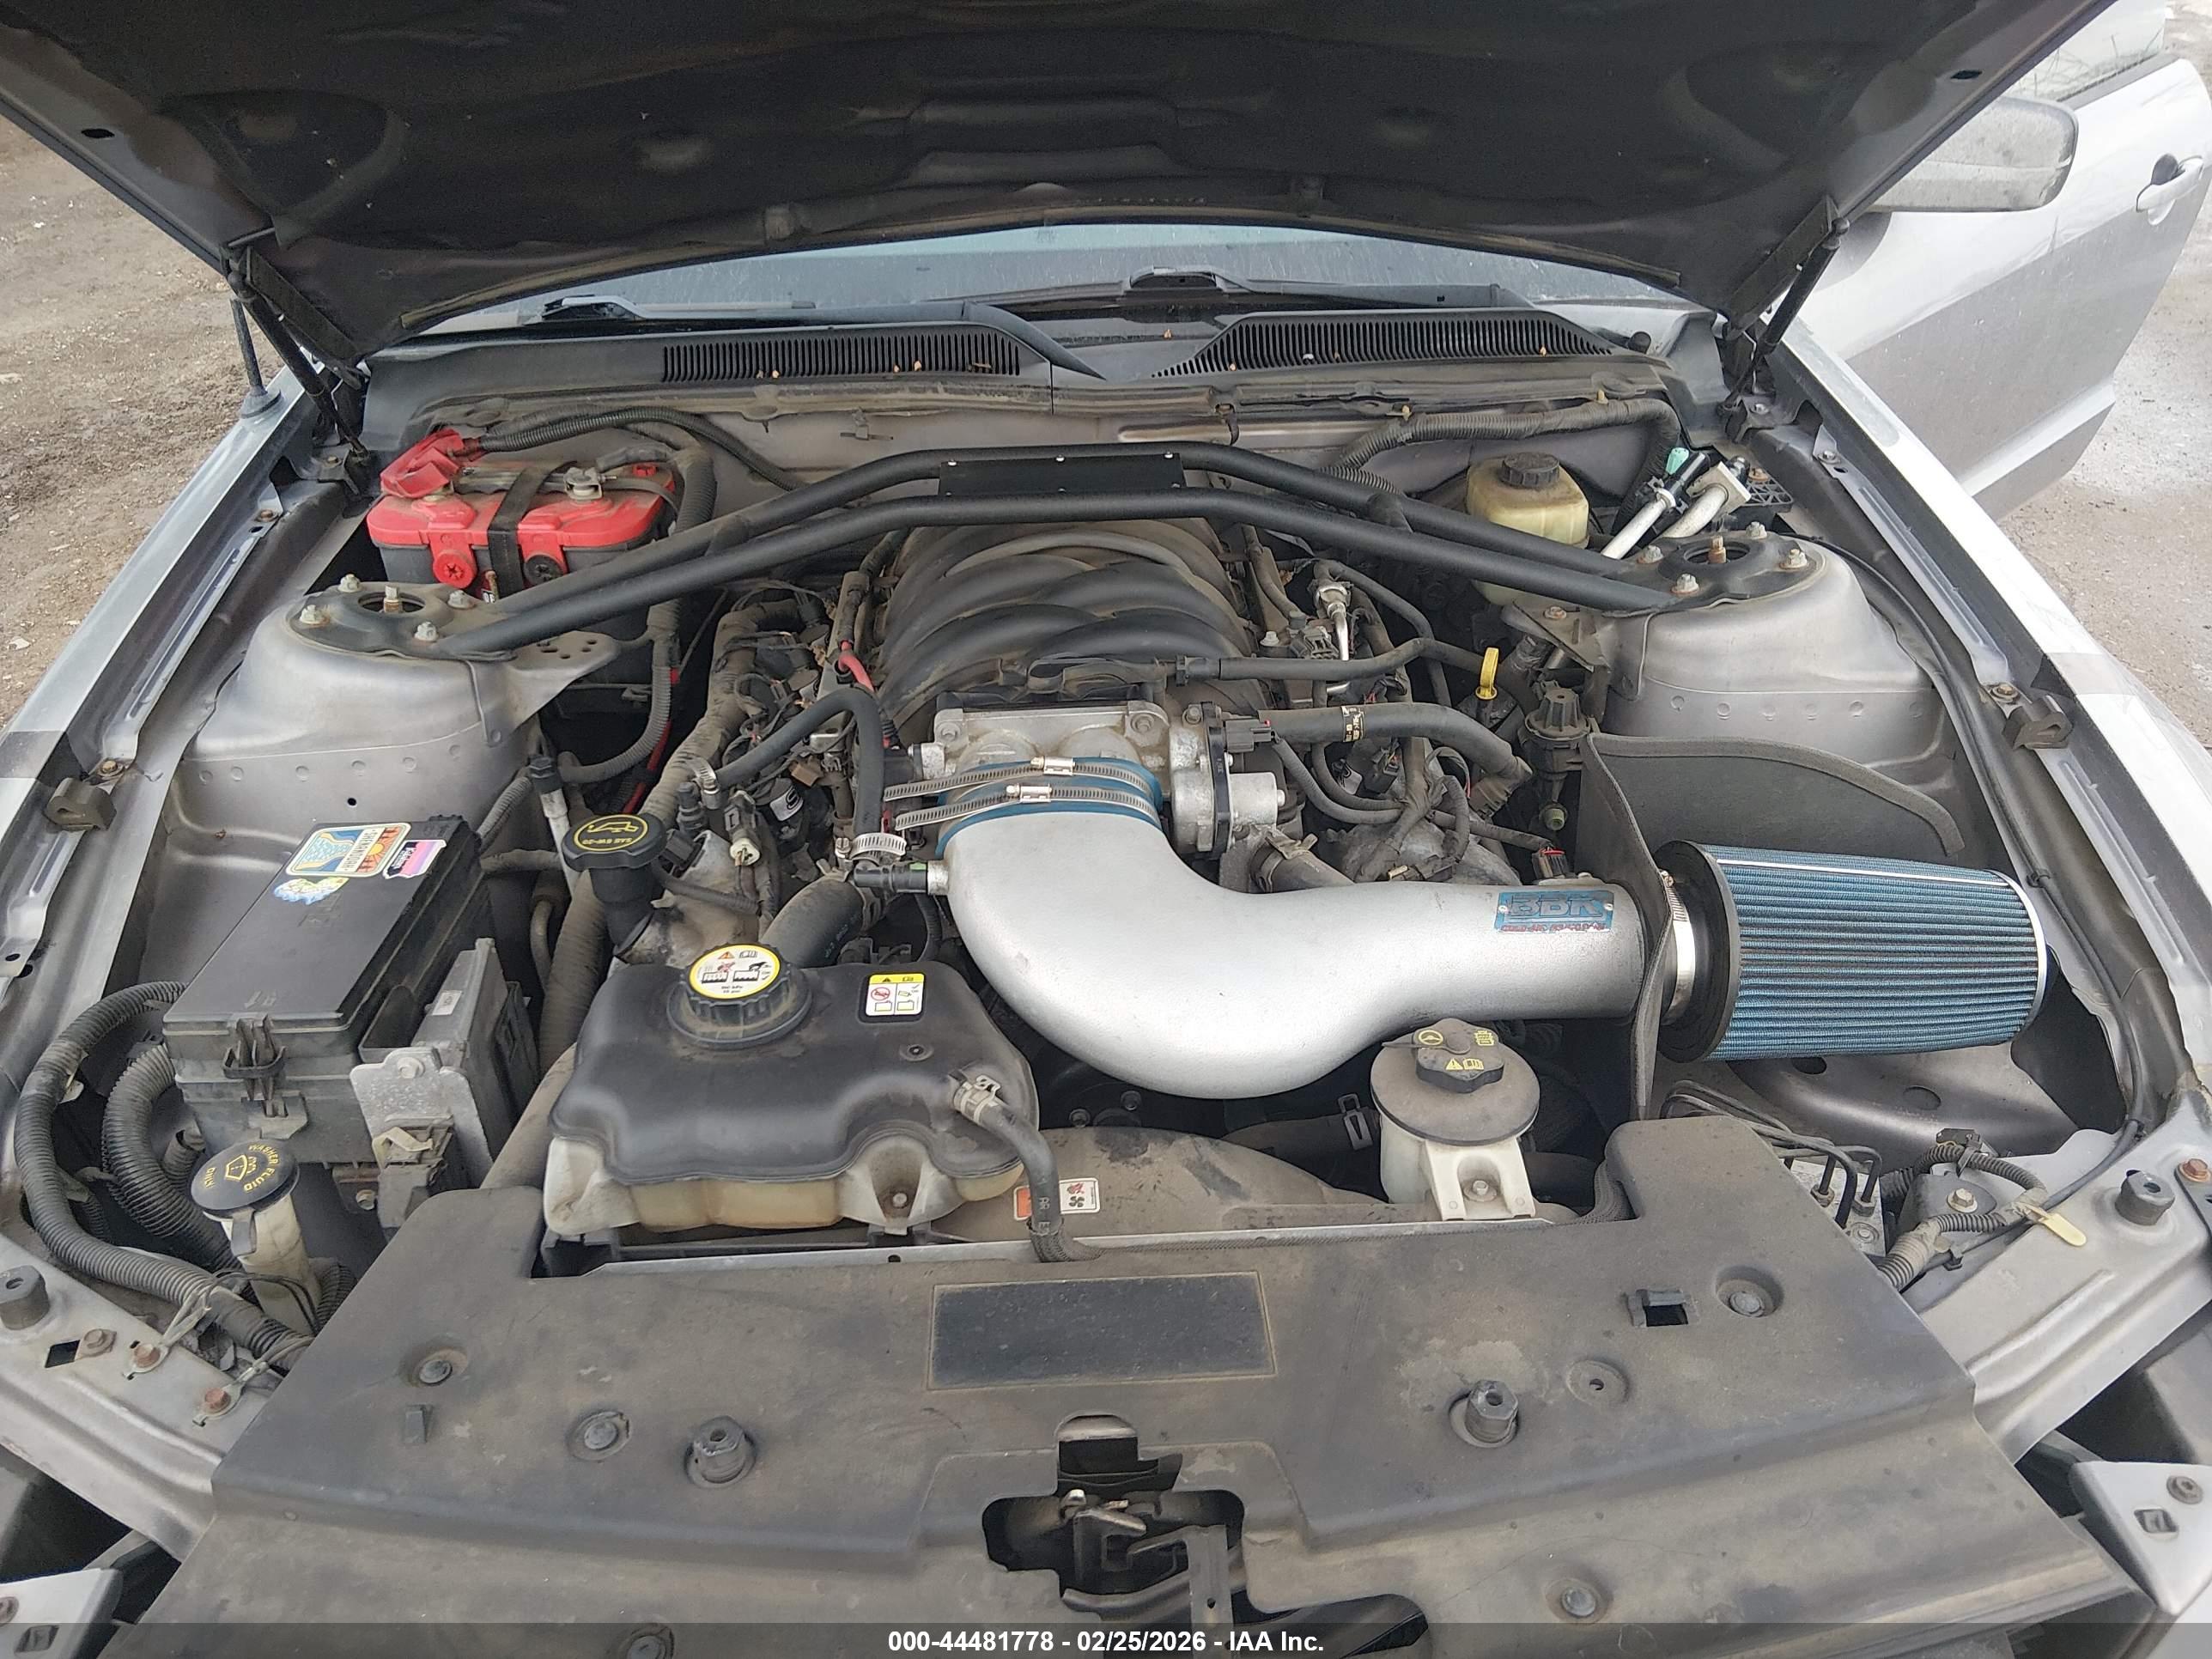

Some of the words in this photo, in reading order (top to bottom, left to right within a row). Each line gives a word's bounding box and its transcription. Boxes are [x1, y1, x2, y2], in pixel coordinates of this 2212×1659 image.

[341, 831, 378, 870] SHENANDOAH
[1510, 893, 1603, 918] BBK
[248, 1143, 281, 1166] WASHER
[243, 1167, 276, 1194] FLUID
